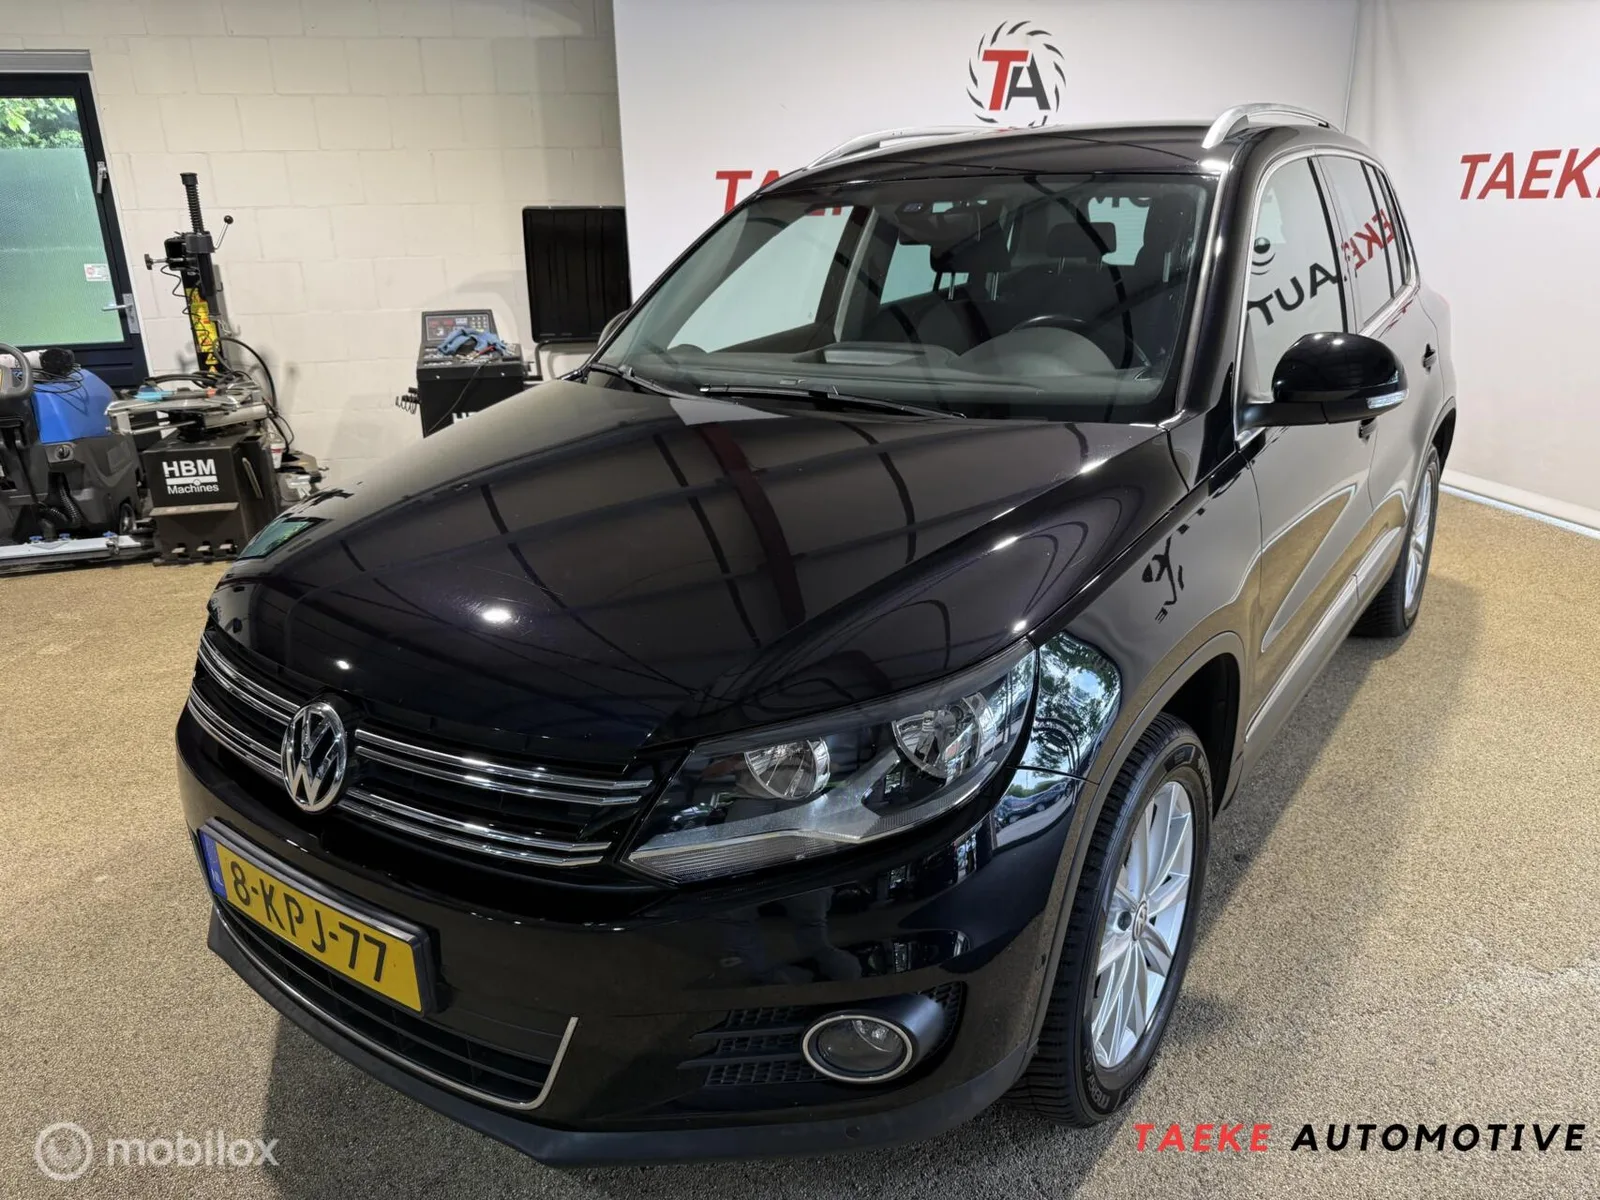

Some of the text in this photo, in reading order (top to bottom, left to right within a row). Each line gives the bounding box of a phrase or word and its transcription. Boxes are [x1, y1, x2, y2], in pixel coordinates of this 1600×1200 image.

[982, 49, 1052, 111] TA
[1460, 147, 1600, 200] TAEK
[162, 458, 217, 478] HBM
[167, 484, 220, 495] Machines
[230, 861, 387, 983] 8-KPJ-77
